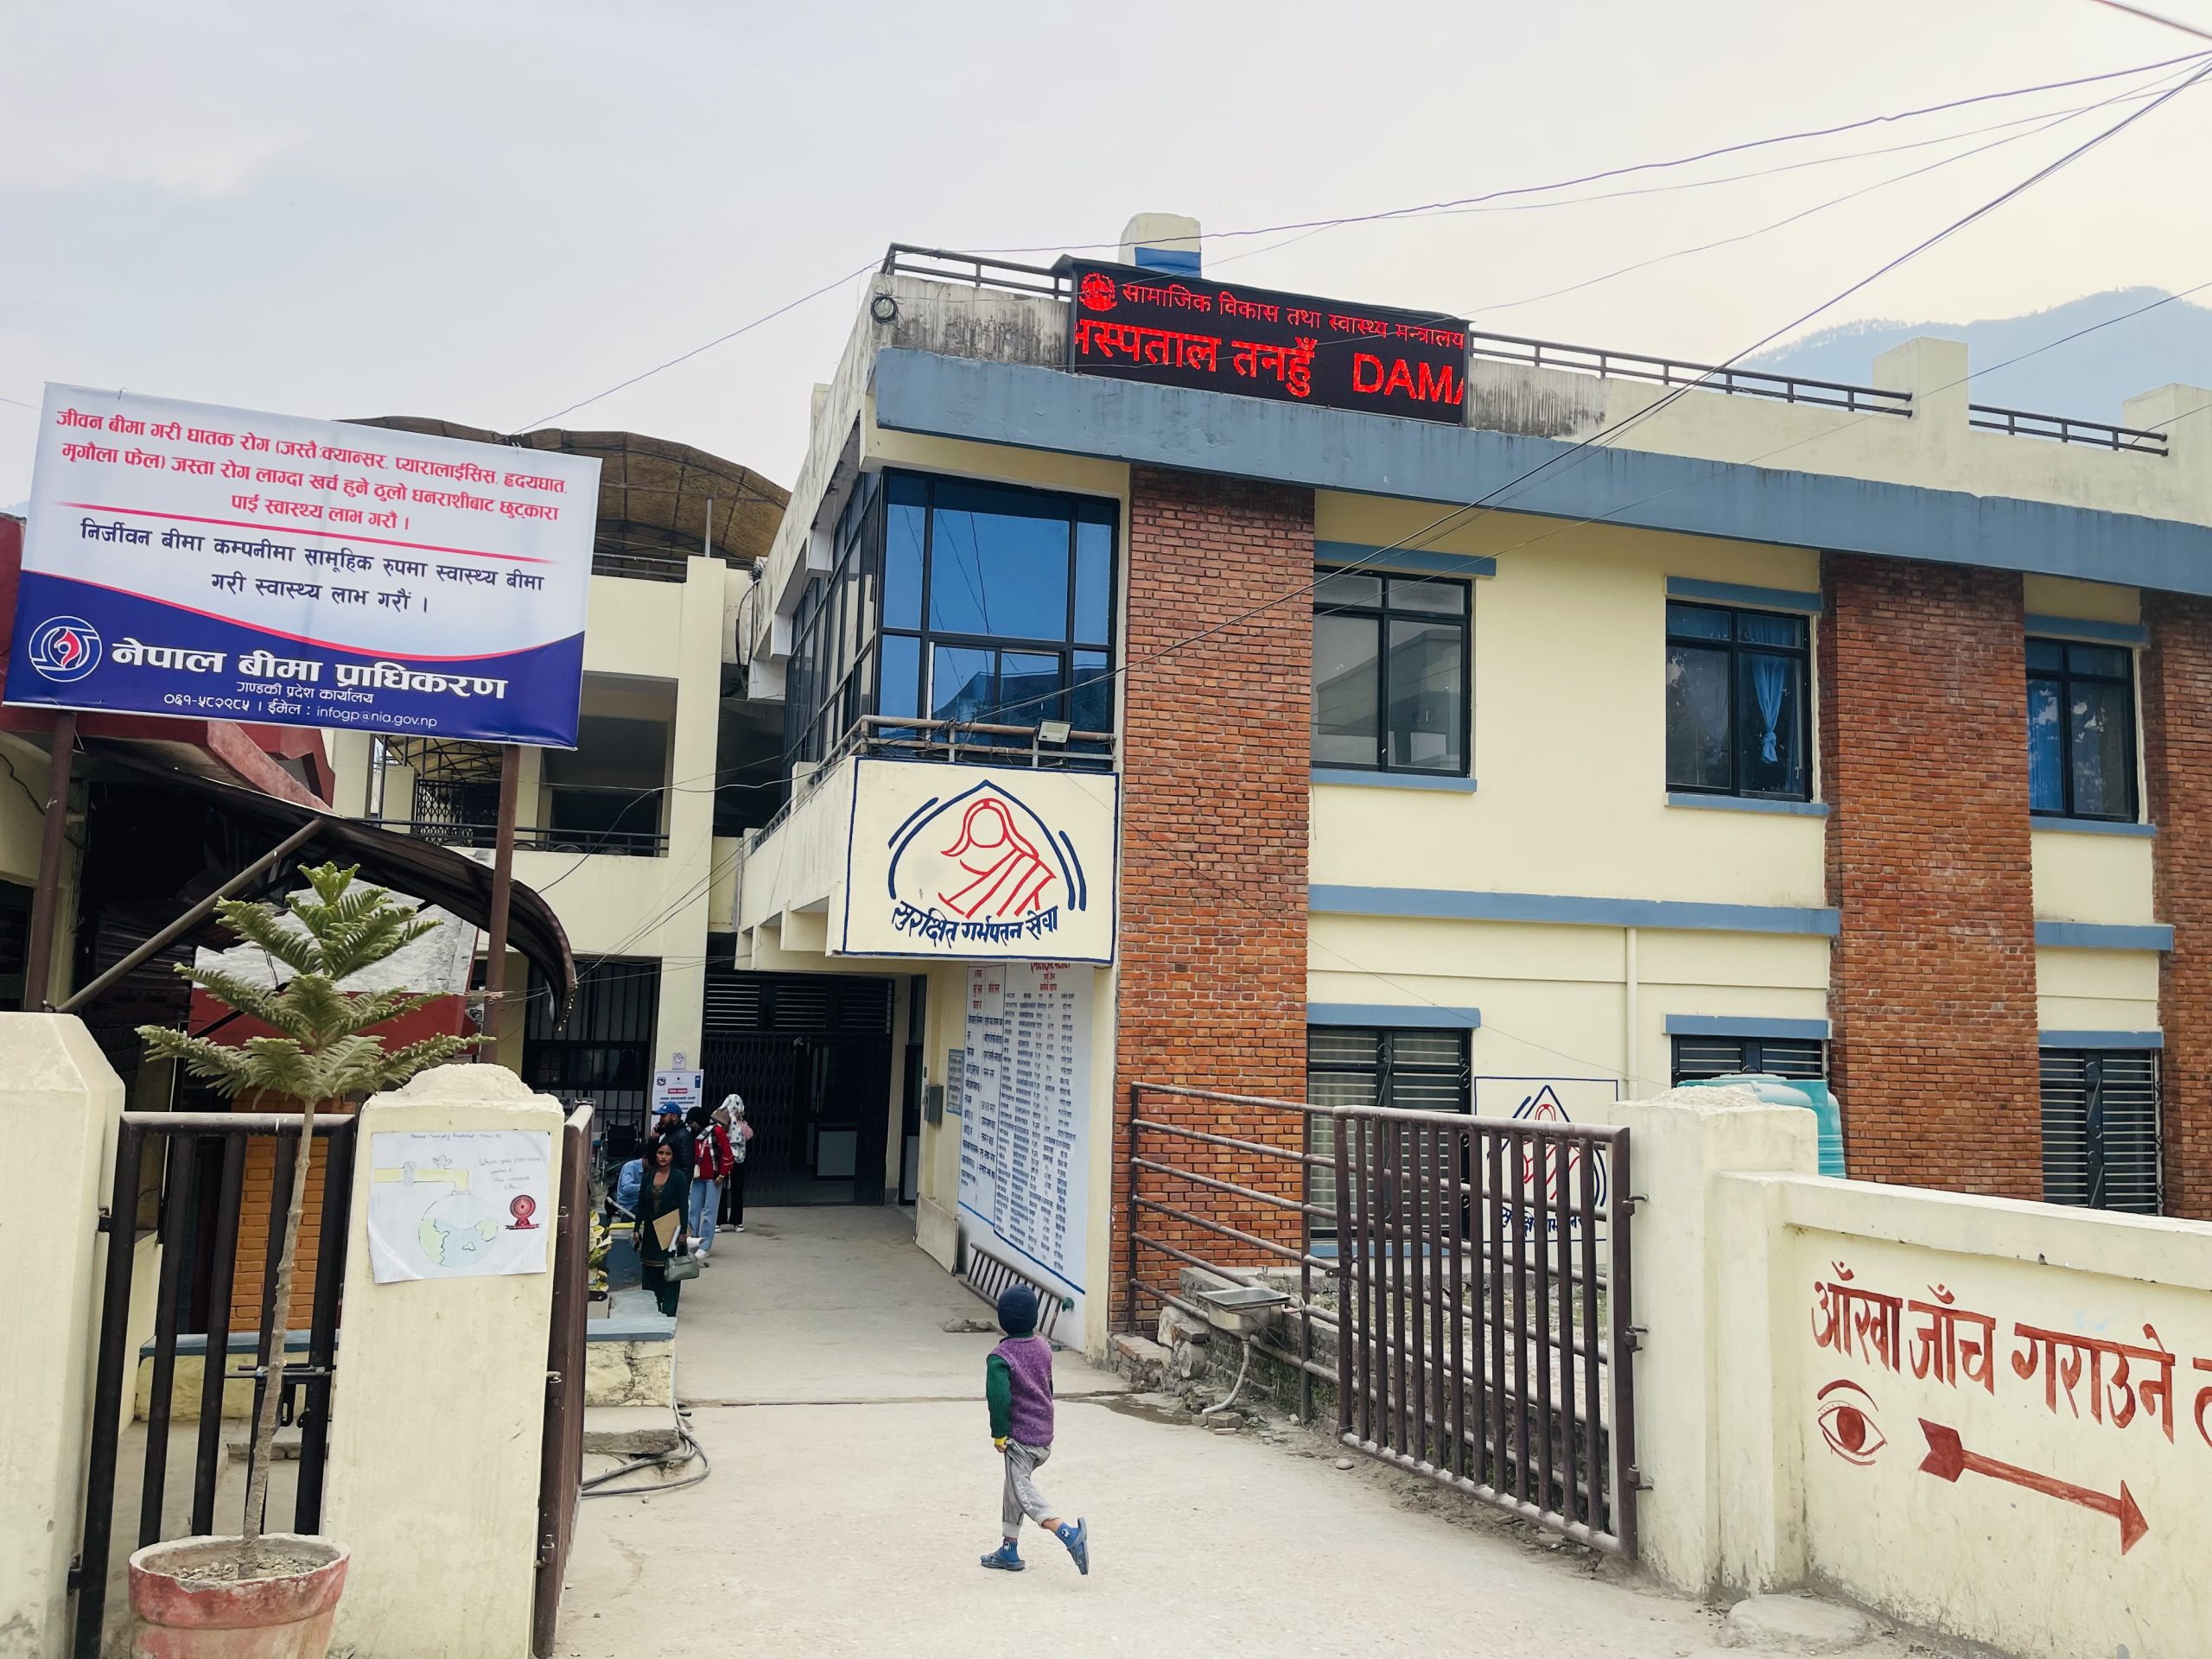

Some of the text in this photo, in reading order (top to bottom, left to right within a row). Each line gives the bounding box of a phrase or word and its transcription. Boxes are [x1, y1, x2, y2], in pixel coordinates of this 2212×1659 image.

[1122, 283, 1465, 350] सामाजिक विकास तथा स्वास्थ्य मन्त्रालय
[1352, 352, 1465, 405] DAM
[56, 408, 104, 430] जीवन
[108, 415, 145, 436] बीमा
[150, 422, 182, 441] गरी
[187, 428, 234, 448] घातक
[240, 432, 270, 453] रोग
[61, 441, 118, 463] मृगौला
[124, 448, 166, 469] फेल)
[171, 456, 215, 476] जस्ता
[220, 460, 251, 480] रोग
[255, 467, 304, 487] लाग्दा
[308, 473, 339, 492] खर्च
[343, 478, 369, 498] हुने
[374, 483, 407, 502] ठुलो
[231, 494, 260, 513] पाई
[264, 499, 323, 519] स्वास्थ्य
[328, 507, 364, 524] लाभ
[80, 518, 544, 591] निर्जीवन बीमा कम्पनीमा सामूहिक रुपमा स्वास्थ्य बीमा
[212, 570, 246, 594] गरी
[255, 578, 322, 600] स्वास्थ्य
[331, 587, 369, 606] लाभ
[378, 588, 411, 613] गरौं
[111, 637, 509, 699] नेपाल बीमा प्राधिकरण
[236, 681, 374, 704] गण्डकी प्रदेश कार्यालय
[267, 698, 302, 715] ईमेल
[316, 706, 438, 729] infogp@nia.gov.np
[891, 899, 1058, 949] सुरक्षित गर्भपतन सेवा
[1811, 1260, 1904, 1375] आँखा
[1908, 1283, 1996, 1396] जाँच
[2011, 1322, 2176, 1445] गराउने
